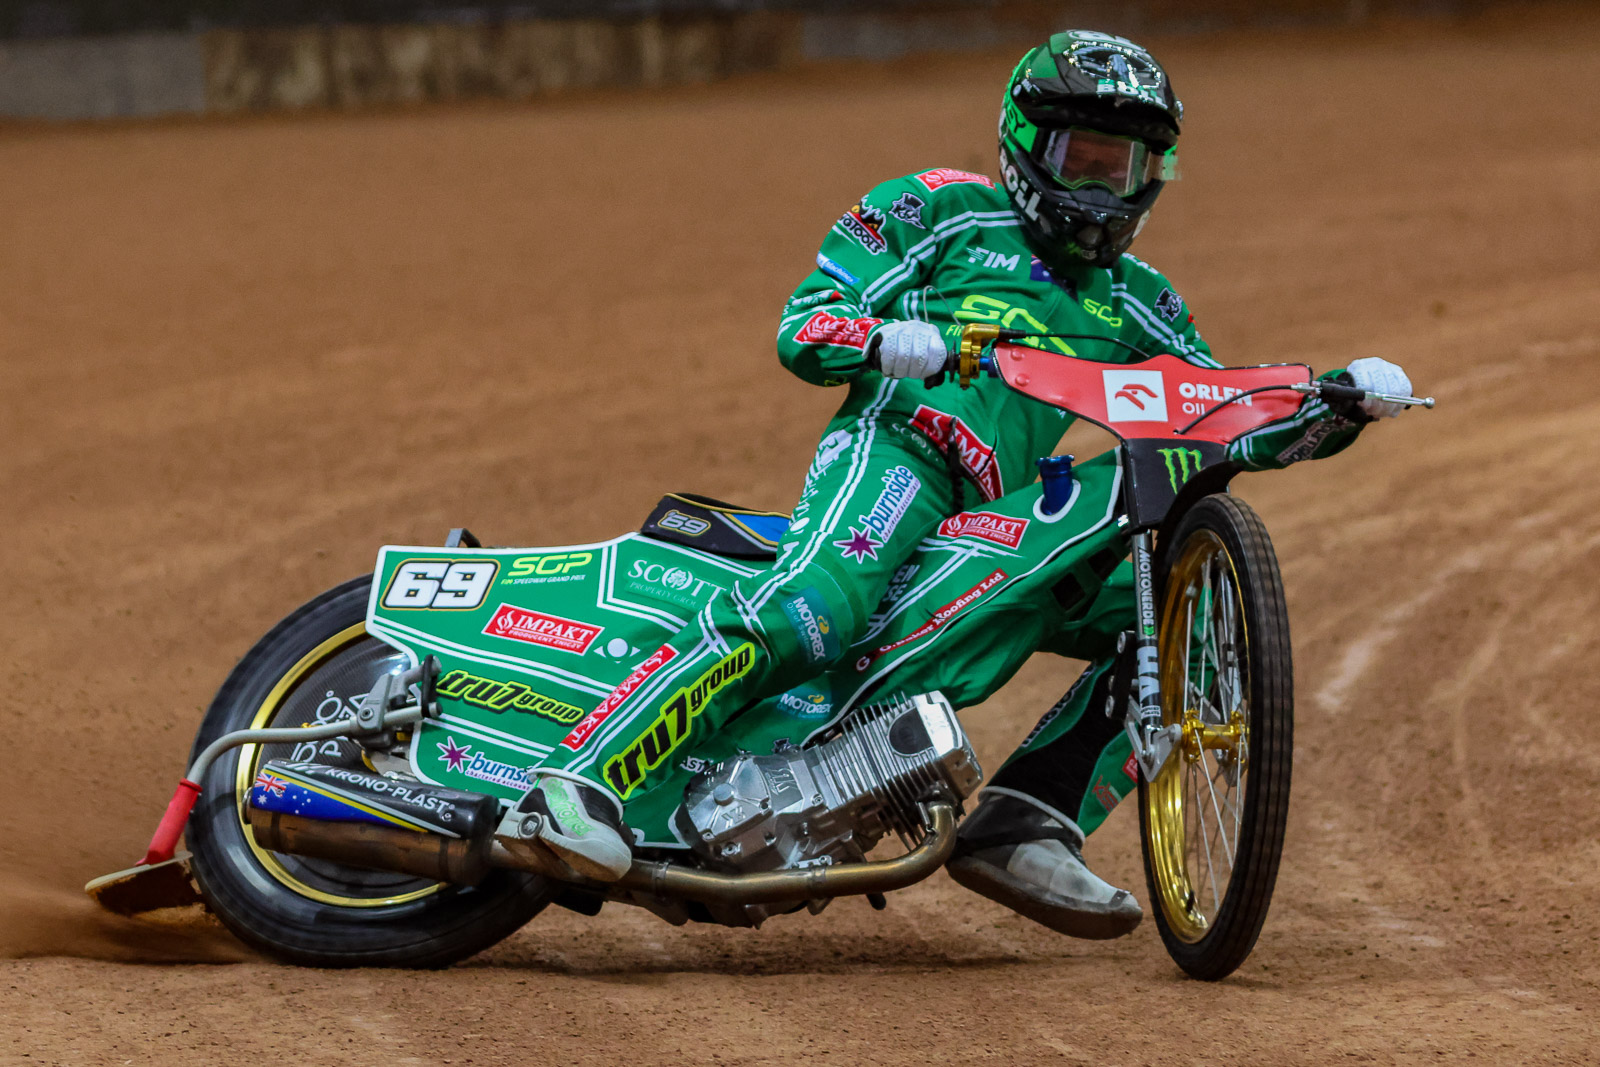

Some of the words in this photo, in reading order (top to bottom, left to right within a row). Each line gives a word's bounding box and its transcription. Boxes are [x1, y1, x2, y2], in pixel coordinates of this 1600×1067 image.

[1178, 382, 1252, 407] ORLEN
[861, 466, 913, 535] burnside
[383, 560, 499, 609] 69
[507, 552, 593, 576] SGP
[1137, 547, 1155, 628] MOTOVERDE
[933, 589, 983, 626] Roofing
[980, 571, 1005, 591] Ltd
[513, 614, 594, 642] IMPAKT
[793, 597, 826, 661] MOTOREX
[688, 642, 755, 717] group
[514, 691, 584, 722] group
[571, 669, 650, 744] IMPAKT
[326, 767, 450, 813] KRONO-PLAST
[469, 752, 533, 785] burnsi
